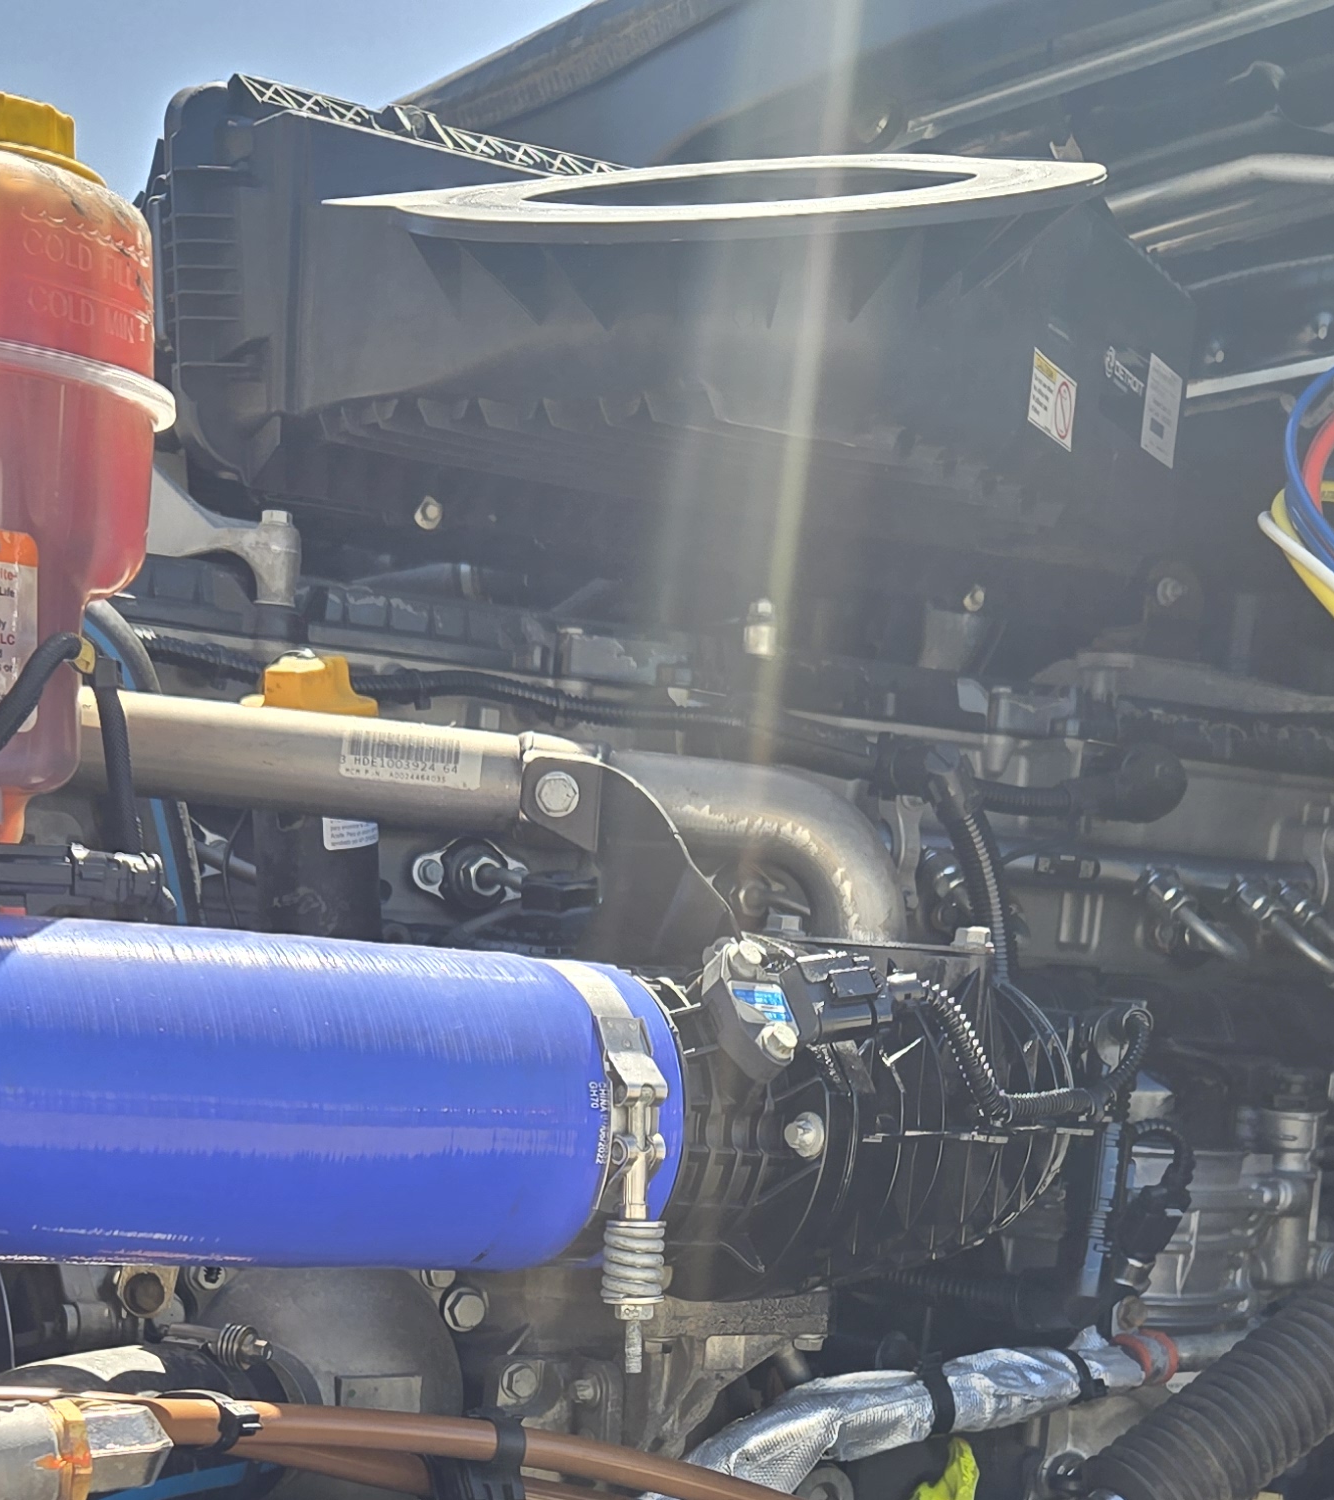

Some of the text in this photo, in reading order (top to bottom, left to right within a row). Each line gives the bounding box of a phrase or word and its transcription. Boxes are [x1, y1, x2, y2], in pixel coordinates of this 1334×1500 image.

[22, 228, 135, 291] COLD FILL
[27, 285, 95, 327] COLD
[1114, 360, 1145, 397] DETROIT
[354, 757, 436, 772] HDE1003924
[588, 1081, 600, 1109] GH70
[598, 1081, 608, 1113] CHINA
